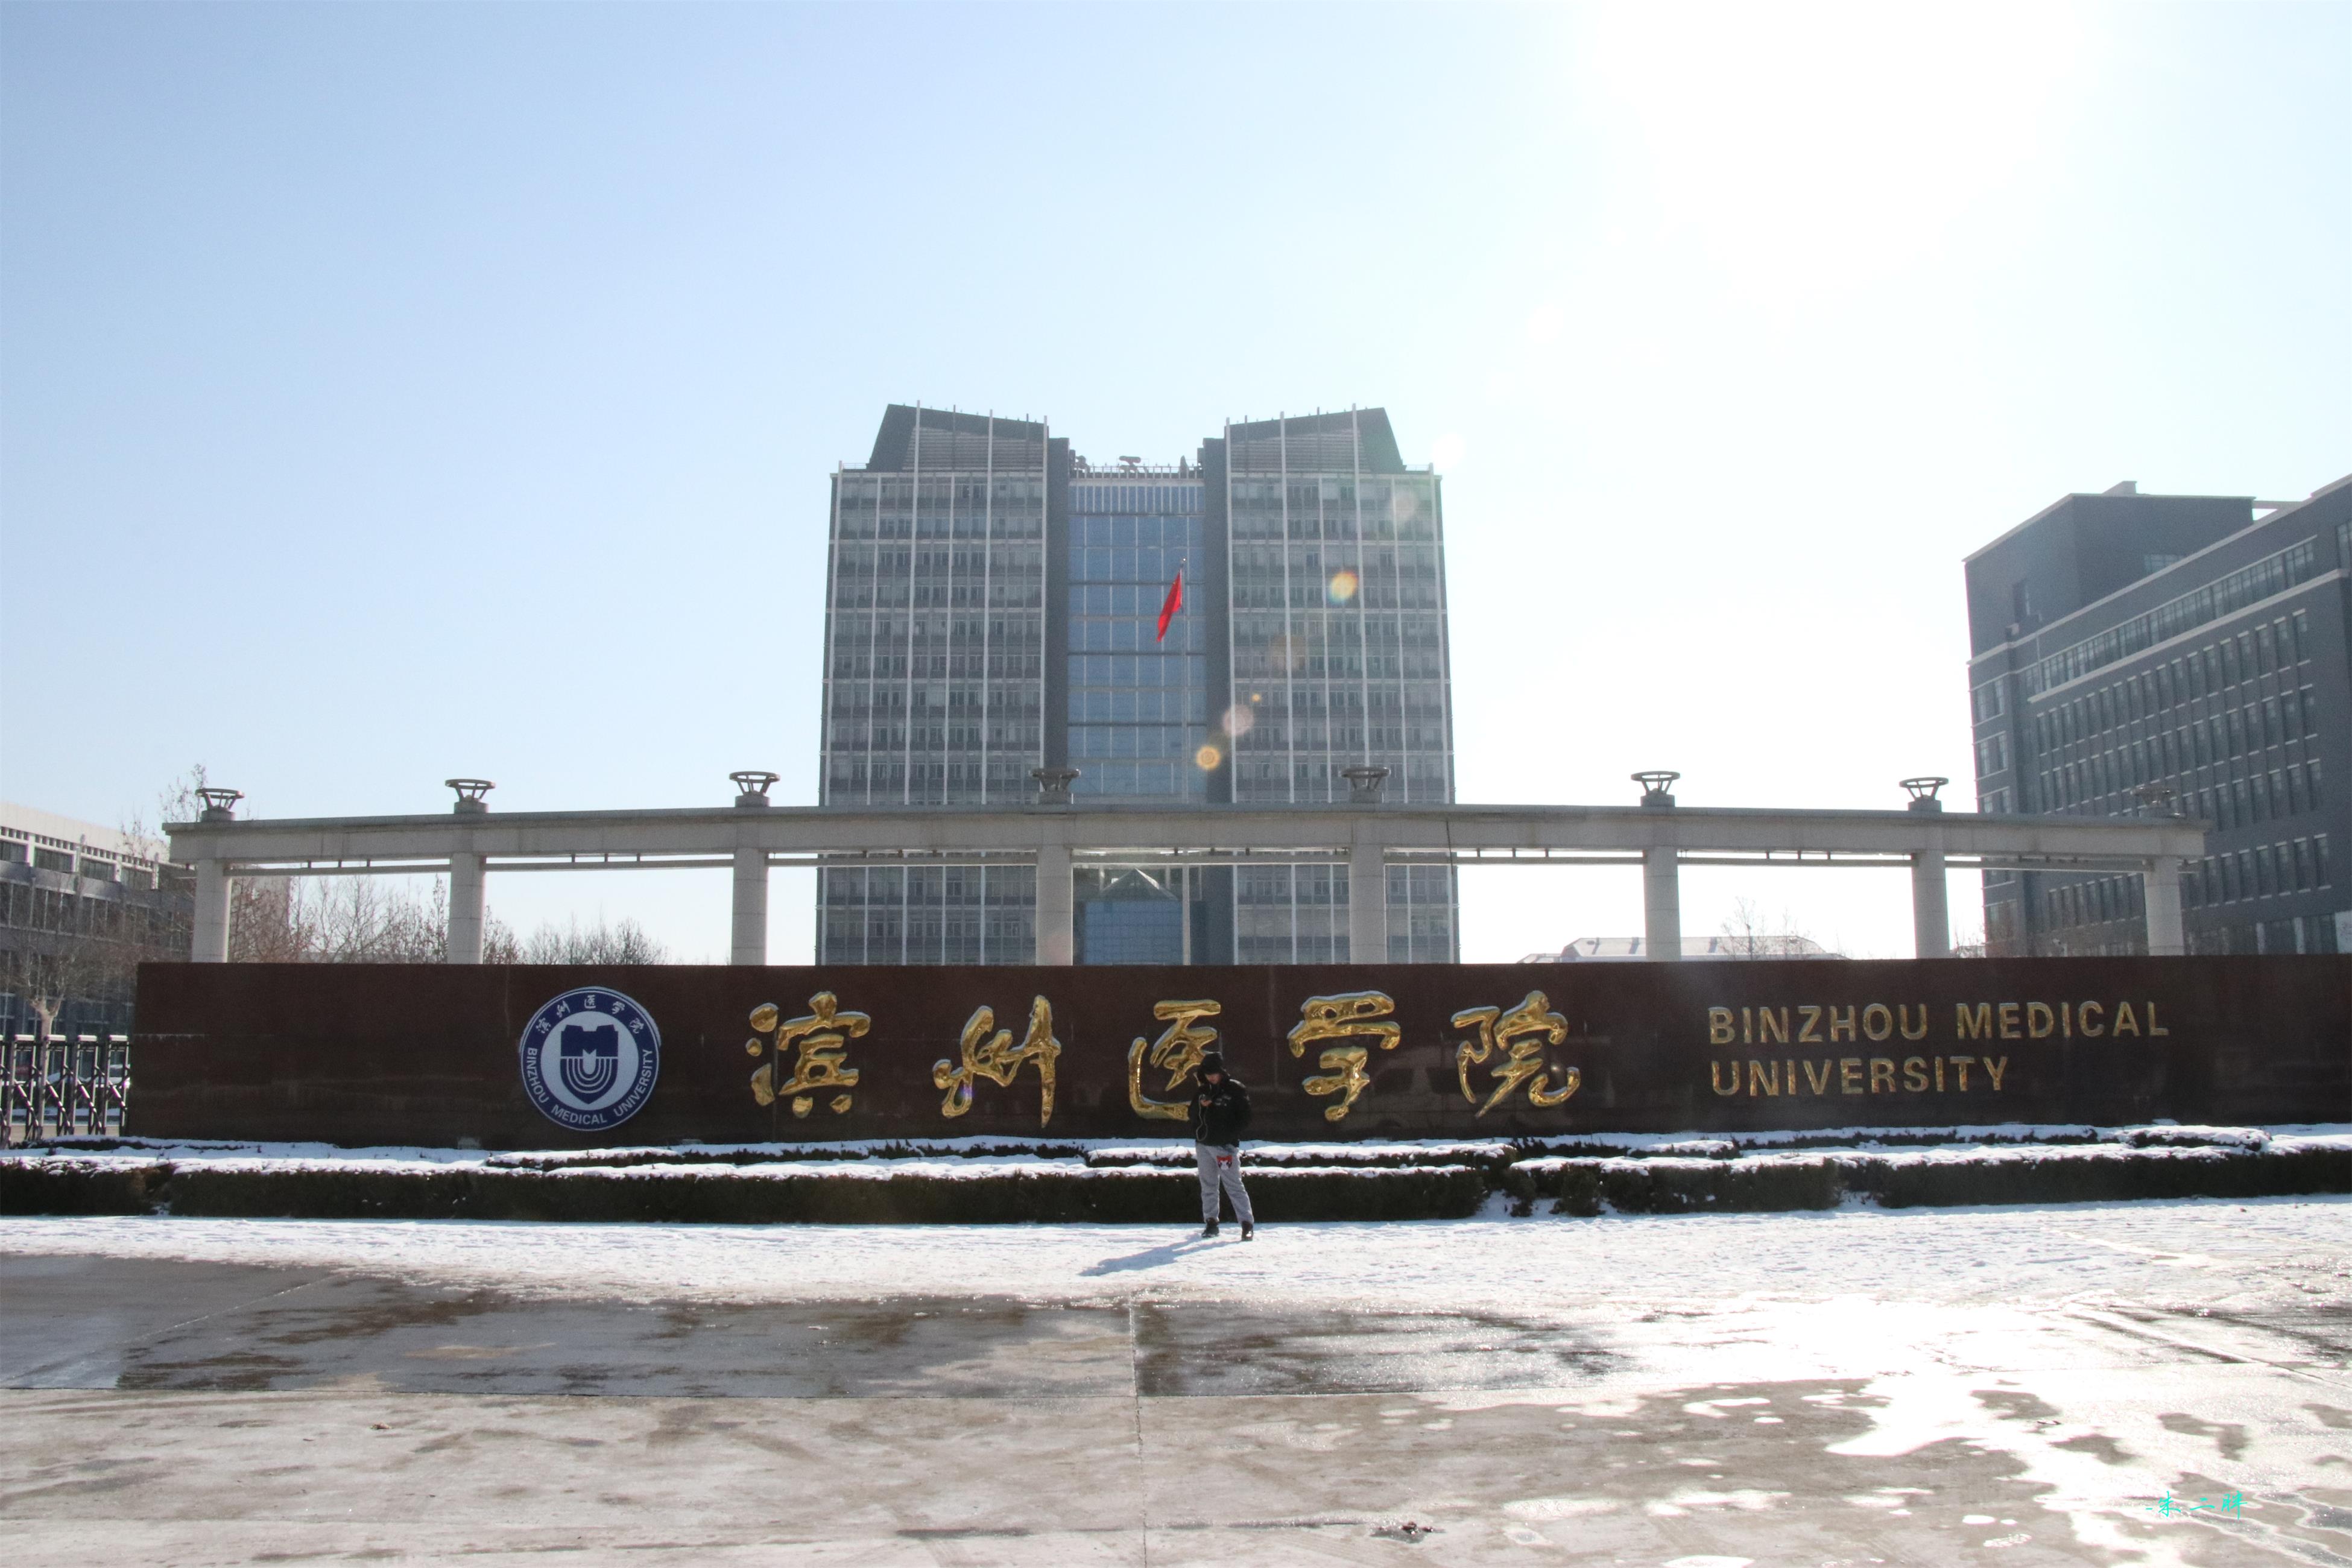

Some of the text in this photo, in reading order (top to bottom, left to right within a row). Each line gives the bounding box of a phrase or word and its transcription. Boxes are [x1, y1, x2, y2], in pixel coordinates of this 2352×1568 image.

[1709, 1001, 2169, 1044] BINZHOU MEDICAL
[526, 1048, 653, 1125] BINZHOU MEDICAL UNIVERSITY
[746, 991, 1580, 1129] 滨州医学院
[1711, 1055, 2008, 1096] UNIVERSITY
